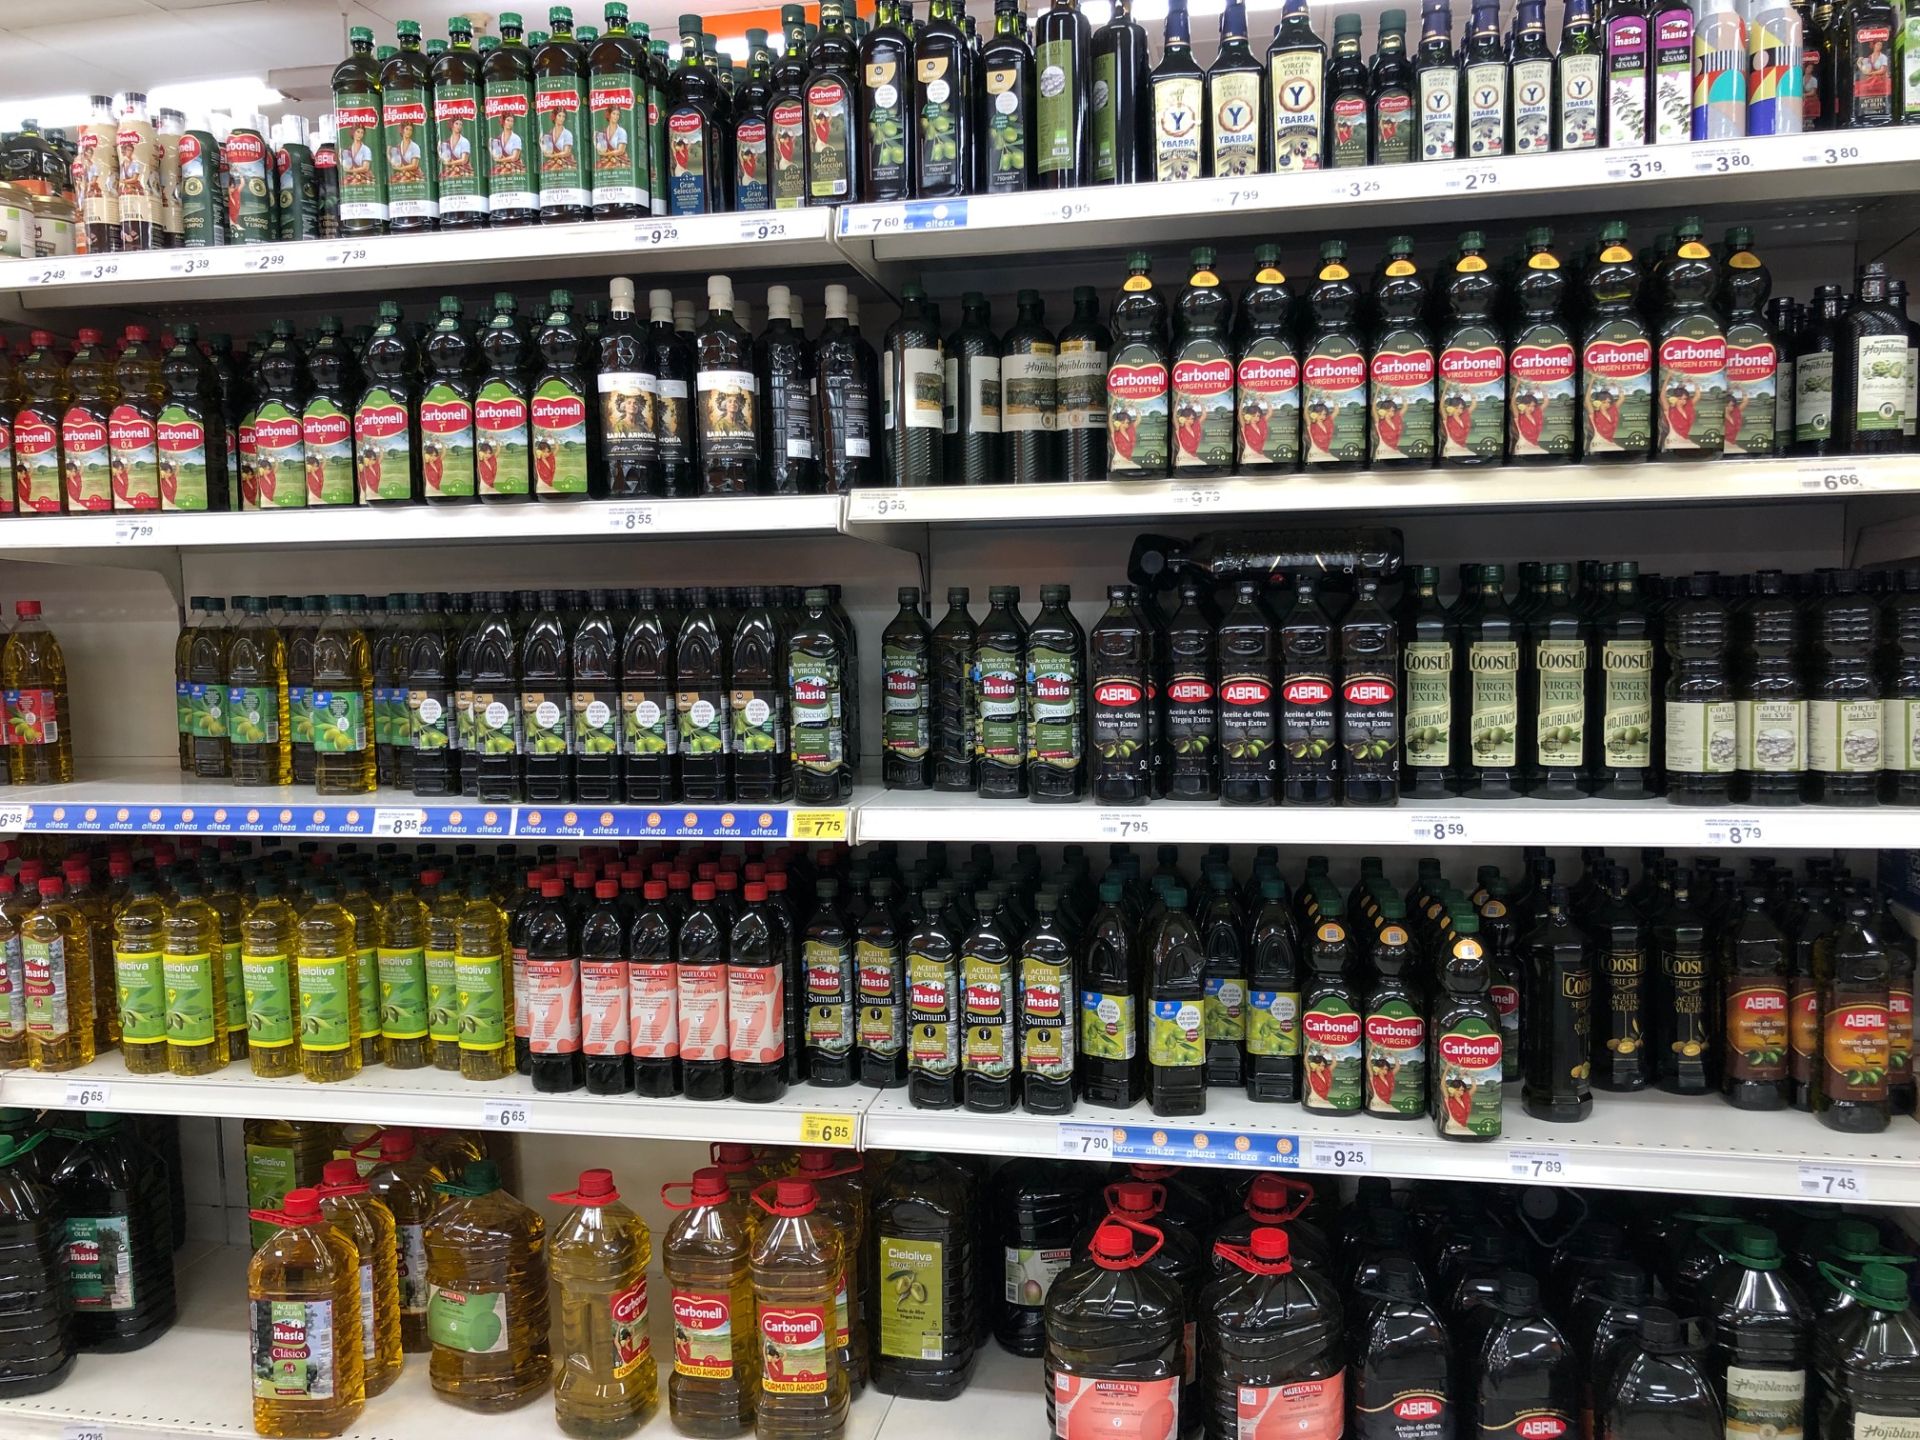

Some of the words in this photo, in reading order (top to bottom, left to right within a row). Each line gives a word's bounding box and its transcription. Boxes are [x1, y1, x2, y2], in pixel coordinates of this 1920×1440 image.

[1661, 30, 1687, 40] masía
[1615, 36, 1640, 46] masía
[1662, 53, 1687, 62] SÉSAMO
[1615, 59, 1640, 68] SÉSAMO
[810, 89, 841, 100] Carbonell
[670, 118, 699, 128] Carbonell
[1279, 114, 1315, 124] YBARRA
[1161, 138, 1196, 148] YBARRA
[1219, 134, 1254, 144] YBARRA
[814, 161, 843, 169] Selección
[1588, 348, 1649, 365] Carbonell
[1442, 355, 1502, 371] Carbonell
[1593, 364, 1620, 373] VIRGEN
[1621, 363, 1646, 372] EXTRA
[1175, 368, 1230, 382] Carbonell
[1306, 364, 1362, 378] Carbonell
[1446, 370, 1472, 379] VIRGEN
[1474, 369, 1498, 378] EXTRA
[1110, 372, 1165, 386] Carbonell
[1310, 378, 1334, 386] VIRGEN
[1336, 376, 1360, 386] EXTRA
[1114, 386, 1136, 395] VIRGEN
[1138, 385, 1160, 394] EXTRA
[1178, 383, 1201, 391] VIRGEN
[1203, 382, 1227, 390] EXTRA
[421, 408, 467, 421] Carbonell
[476, 405, 522, 419] Carbonell
[532, 404, 580, 417] Carbonell
[1040, 663, 1065, 671] VIRGEN
[1411, 681, 1447, 691] VIRGEN
[1543, 680, 1581, 691] VIRGEN
[795, 689, 826, 700] masía
[1037, 686, 1070, 696] masía
[1100, 689, 1136, 700] ABRIL
[1172, 685, 1209, 699] ABRIL
[1226, 686, 1265, 700] ABRIL
[1350, 686, 1390, 699] ABRIL
[1546, 691, 1580, 700] EXTRA
[1413, 692, 1447, 701] EXTRA
[795, 711, 829, 719] Selección
[1036, 707, 1072, 715] Selección
[1098, 720, 1118, 728] Virgen
[1407, 711, 1449, 729] HOJIBLANCA
[1540, 711, 1582, 728] HOJIBLANCA
[441, 825, 467, 834] alteza
[520, 825, 546, 834] alteza
[713, 826, 741, 836] alteza
[751, 827, 778, 836] alteza
[1030, 968, 1052, 976] ACEITE
[913, 992, 944, 1004] masía
[1027, 996, 1059, 1008] masía
[1745, 997, 1784, 1010] ABRIL
[912, 1012, 947, 1021] Sumum
[1026, 1015, 1062, 1026] Sumum
[1845, 1015, 1885, 1027] ABRIL
[1306, 1020, 1358, 1032] Carbonell
[1318, 1033, 1347, 1042] VIRGEN
[1443, 1042, 1499, 1055] Carbonell
[1457, 1056, 1488, 1065] VIRGEN
[1228, 1151, 1257, 1161] alteza
[889, 1248, 933, 1261] Cieloliva
[71, 1271, 102, 1280] Lindoliva
[674, 1304, 722, 1319] Carbonell
[691, 1320, 703, 1328] 0,4
[764, 1321, 817, 1332] Carbonell
[274, 1330, 304, 1341] masía
[784, 1335, 797, 1343] 0,4
[272, 1348, 306, 1358] Clásico
[703, 1368, 731, 1377] AHORRO
[793, 1382, 825, 1391] AHORRO
[1096, 1382, 1138, 1392] MUELOLIVA
[1283, 1385, 1323, 1396] MUELOLIVA
[1400, 1404, 1437, 1415] ABRIL
[1522, 1422, 1561, 1434] ABRIL
